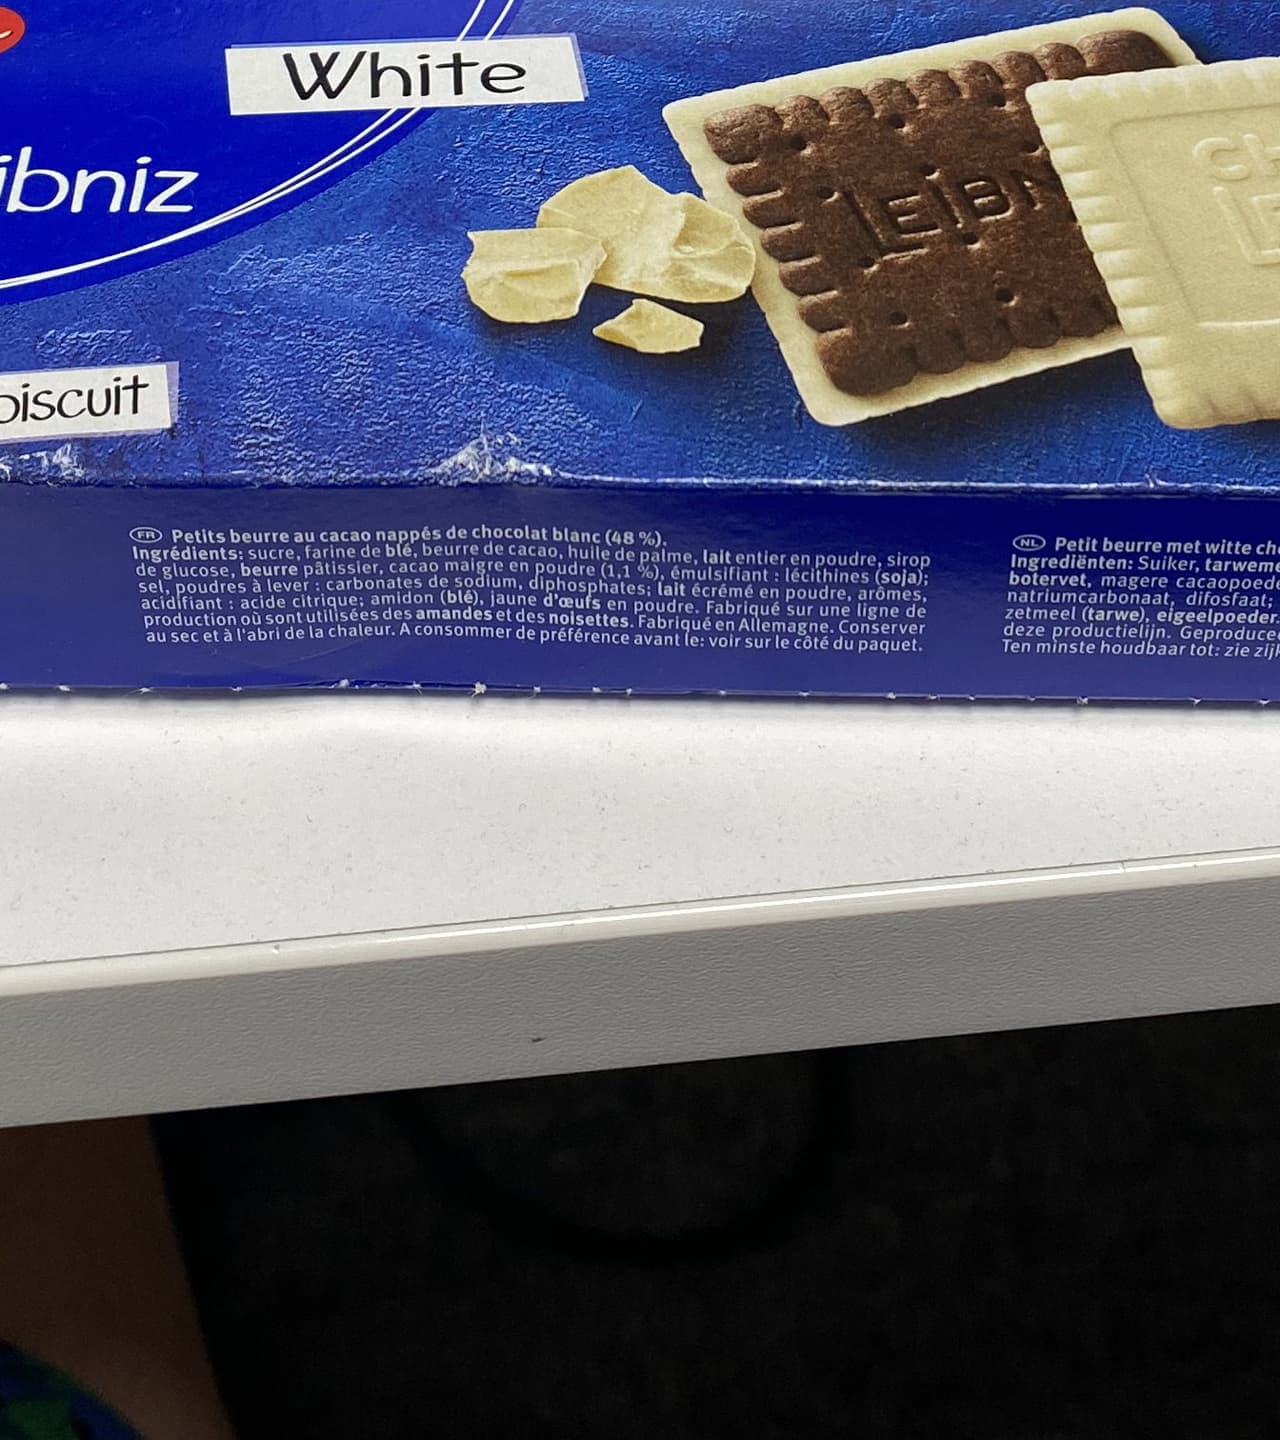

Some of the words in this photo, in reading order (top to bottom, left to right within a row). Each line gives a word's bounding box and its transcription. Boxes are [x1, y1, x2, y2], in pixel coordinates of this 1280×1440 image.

[284, 51, 528, 102] White
[171, 528, 226, 543] Petits
[229, 528, 290, 543] beurre
[293, 531, 315, 542] au
[319, 530, 372, 542] cacao
[375, 525, 442, 545] nappés
[445, 525, 468, 539] de
[471, 525, 548, 541] chocolat
[552, 527, 601, 543] blanc
[604, 529, 634, 547] (48
[638, 530, 667, 548] %).
[1054, 537, 1098, 552] Petit
[1100, 538, 1162, 553] beurre
[1165, 539, 1201, 554] met
[1203, 539, 1252, 555] witte
[132, 545, 244, 563] Ingrédients:
[247, 548, 301, 562] sucre,
[304, 543, 356, 559] farine
[360, 542, 381, 558] de
[384, 542, 418, 559] blé,
[422, 541, 479, 557] beurre
[482, 541, 504, 556] de
[508, 545, 564, 561] cacao,
[568, 544, 610, 561] huile
[614, 546, 636, 561] de
[639, 547, 698, 567] palme,
[702, 549, 732, 564] lait
[734, 550, 786, 565] entier
[790, 554, 810, 565] en
[814, 551, 882, 570] poudre,
[886, 552, 931, 570] sirop
[1009, 553, 1133, 573] Ingrediënten:
[1136, 556, 1200, 574] Suiker,
[135, 562, 156, 577] de
[161, 562, 236, 581] glucose,
[240, 561, 298, 577] beurre
[303, 559, 384, 579] pâtissier,
[388, 562, 439, 573] cacao
[444, 558, 504, 576] maigre
[508, 562, 529, 574] en
[534, 560, 596, 580] poudre
[600, 562, 630, 580] (1,1
[636, 564, 665, 582] %),
[670, 565, 768, 582] émulsifiant
[784, 567, 870, 584] lécithines
[874, 569, 928, 588] (soja);
[1007, 571, 1092, 589] botervet,
[1099, 576, 1168, 592] magere
[146, 632, 166, 643] au
[170, 631, 198, 642] sec
[202, 627, 220, 642] et
[236, 626, 280, 642] l'abri
[284, 625, 305, 640] de
[308, 624, 324, 639] la
[328, 621, 396, 638] chaleur.
[414, 625, 512, 639] consommer
[515, 625, 536, 640] de
[540, 626, 630, 648] préférence
[633, 630, 680, 646] avant
[684, 632, 704, 647] le:
[708, 633, 741, 648] voir
[744, 637, 772, 649] sur
[774, 634, 790, 649] le
[793, 635, 830, 650] côté
[832, 636, 854, 651] du
[858, 636, 922, 655] paquet.
[1002, 622, 1045, 637] deze
[1051, 623, 1172, 643] productielijn.
[1002, 639, 1031, 654] Ten
[1034, 639, 1095, 655] minste
[1098, 640, 1186, 656] houdbaar
[1188, 642, 1219, 656] tot:
[1222, 642, 1250, 657] zie
